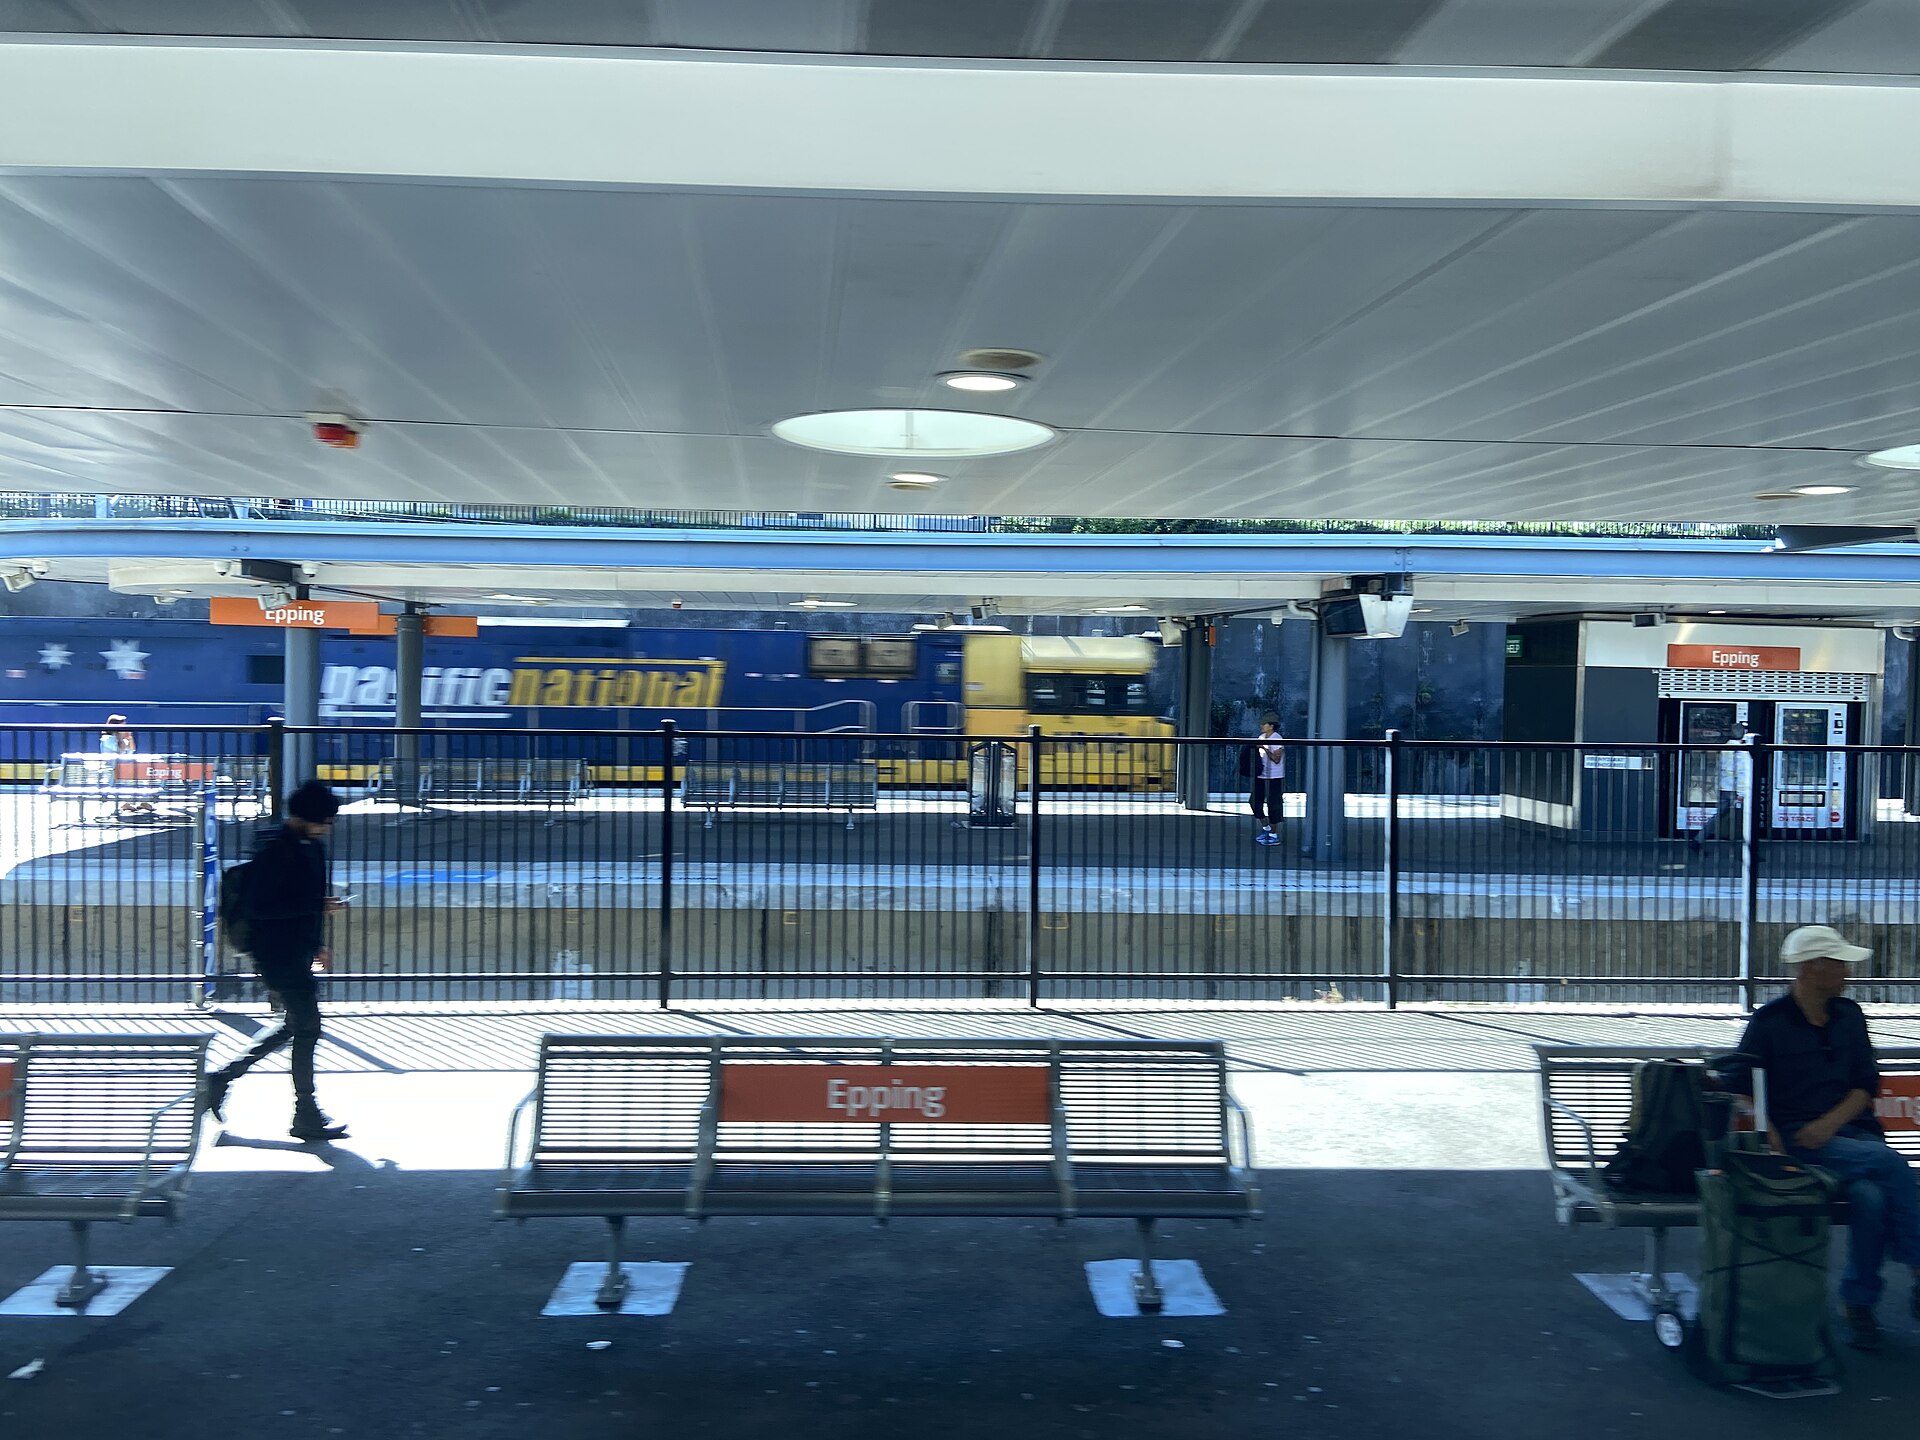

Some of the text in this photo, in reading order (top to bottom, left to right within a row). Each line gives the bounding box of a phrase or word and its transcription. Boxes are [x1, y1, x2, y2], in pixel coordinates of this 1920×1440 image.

[265, 606, 325, 625] Epping
[1712, 650, 1760, 667] Epping
[318, 660, 727, 717] paific national
[826, 1078, 947, 1118] Epping
